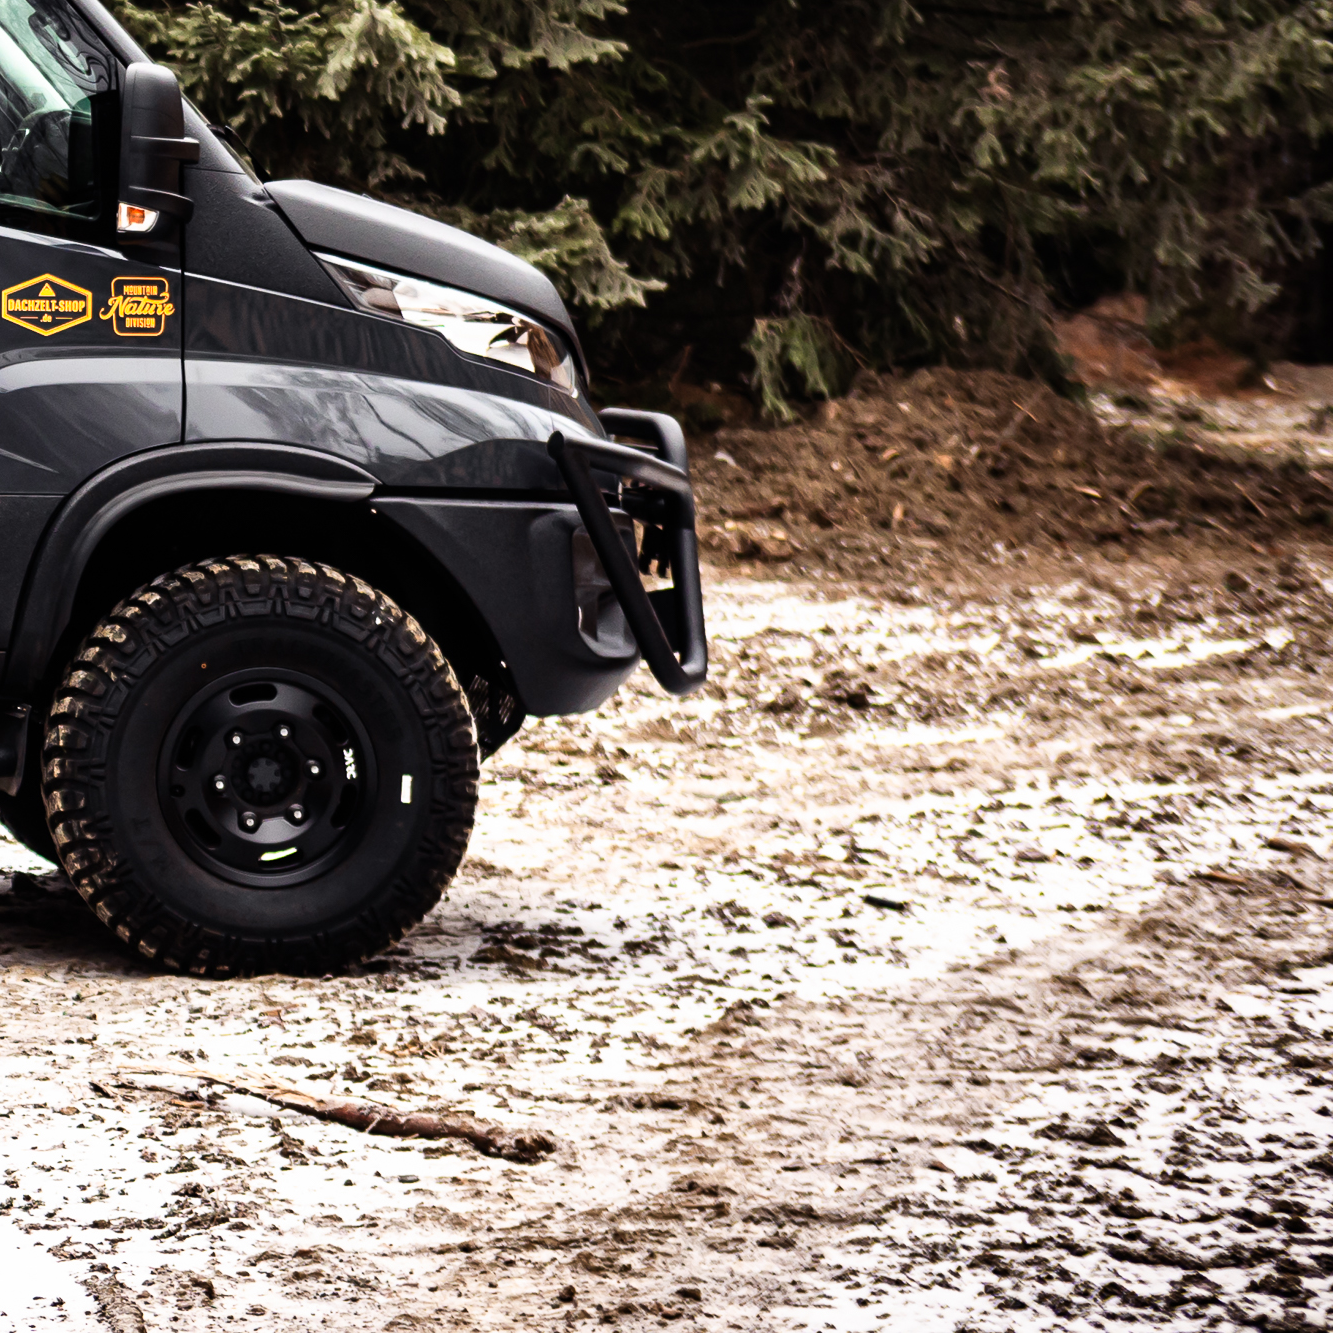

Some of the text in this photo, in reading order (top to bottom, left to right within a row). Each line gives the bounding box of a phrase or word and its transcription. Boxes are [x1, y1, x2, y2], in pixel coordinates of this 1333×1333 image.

[123, 284, 159, 296] MOUNTAIN
[7, 298, 87, 313] DACHZELT-SHOP
[99, 292, 176, 321] Nature
[125, 317, 156, 328] DIVISION
